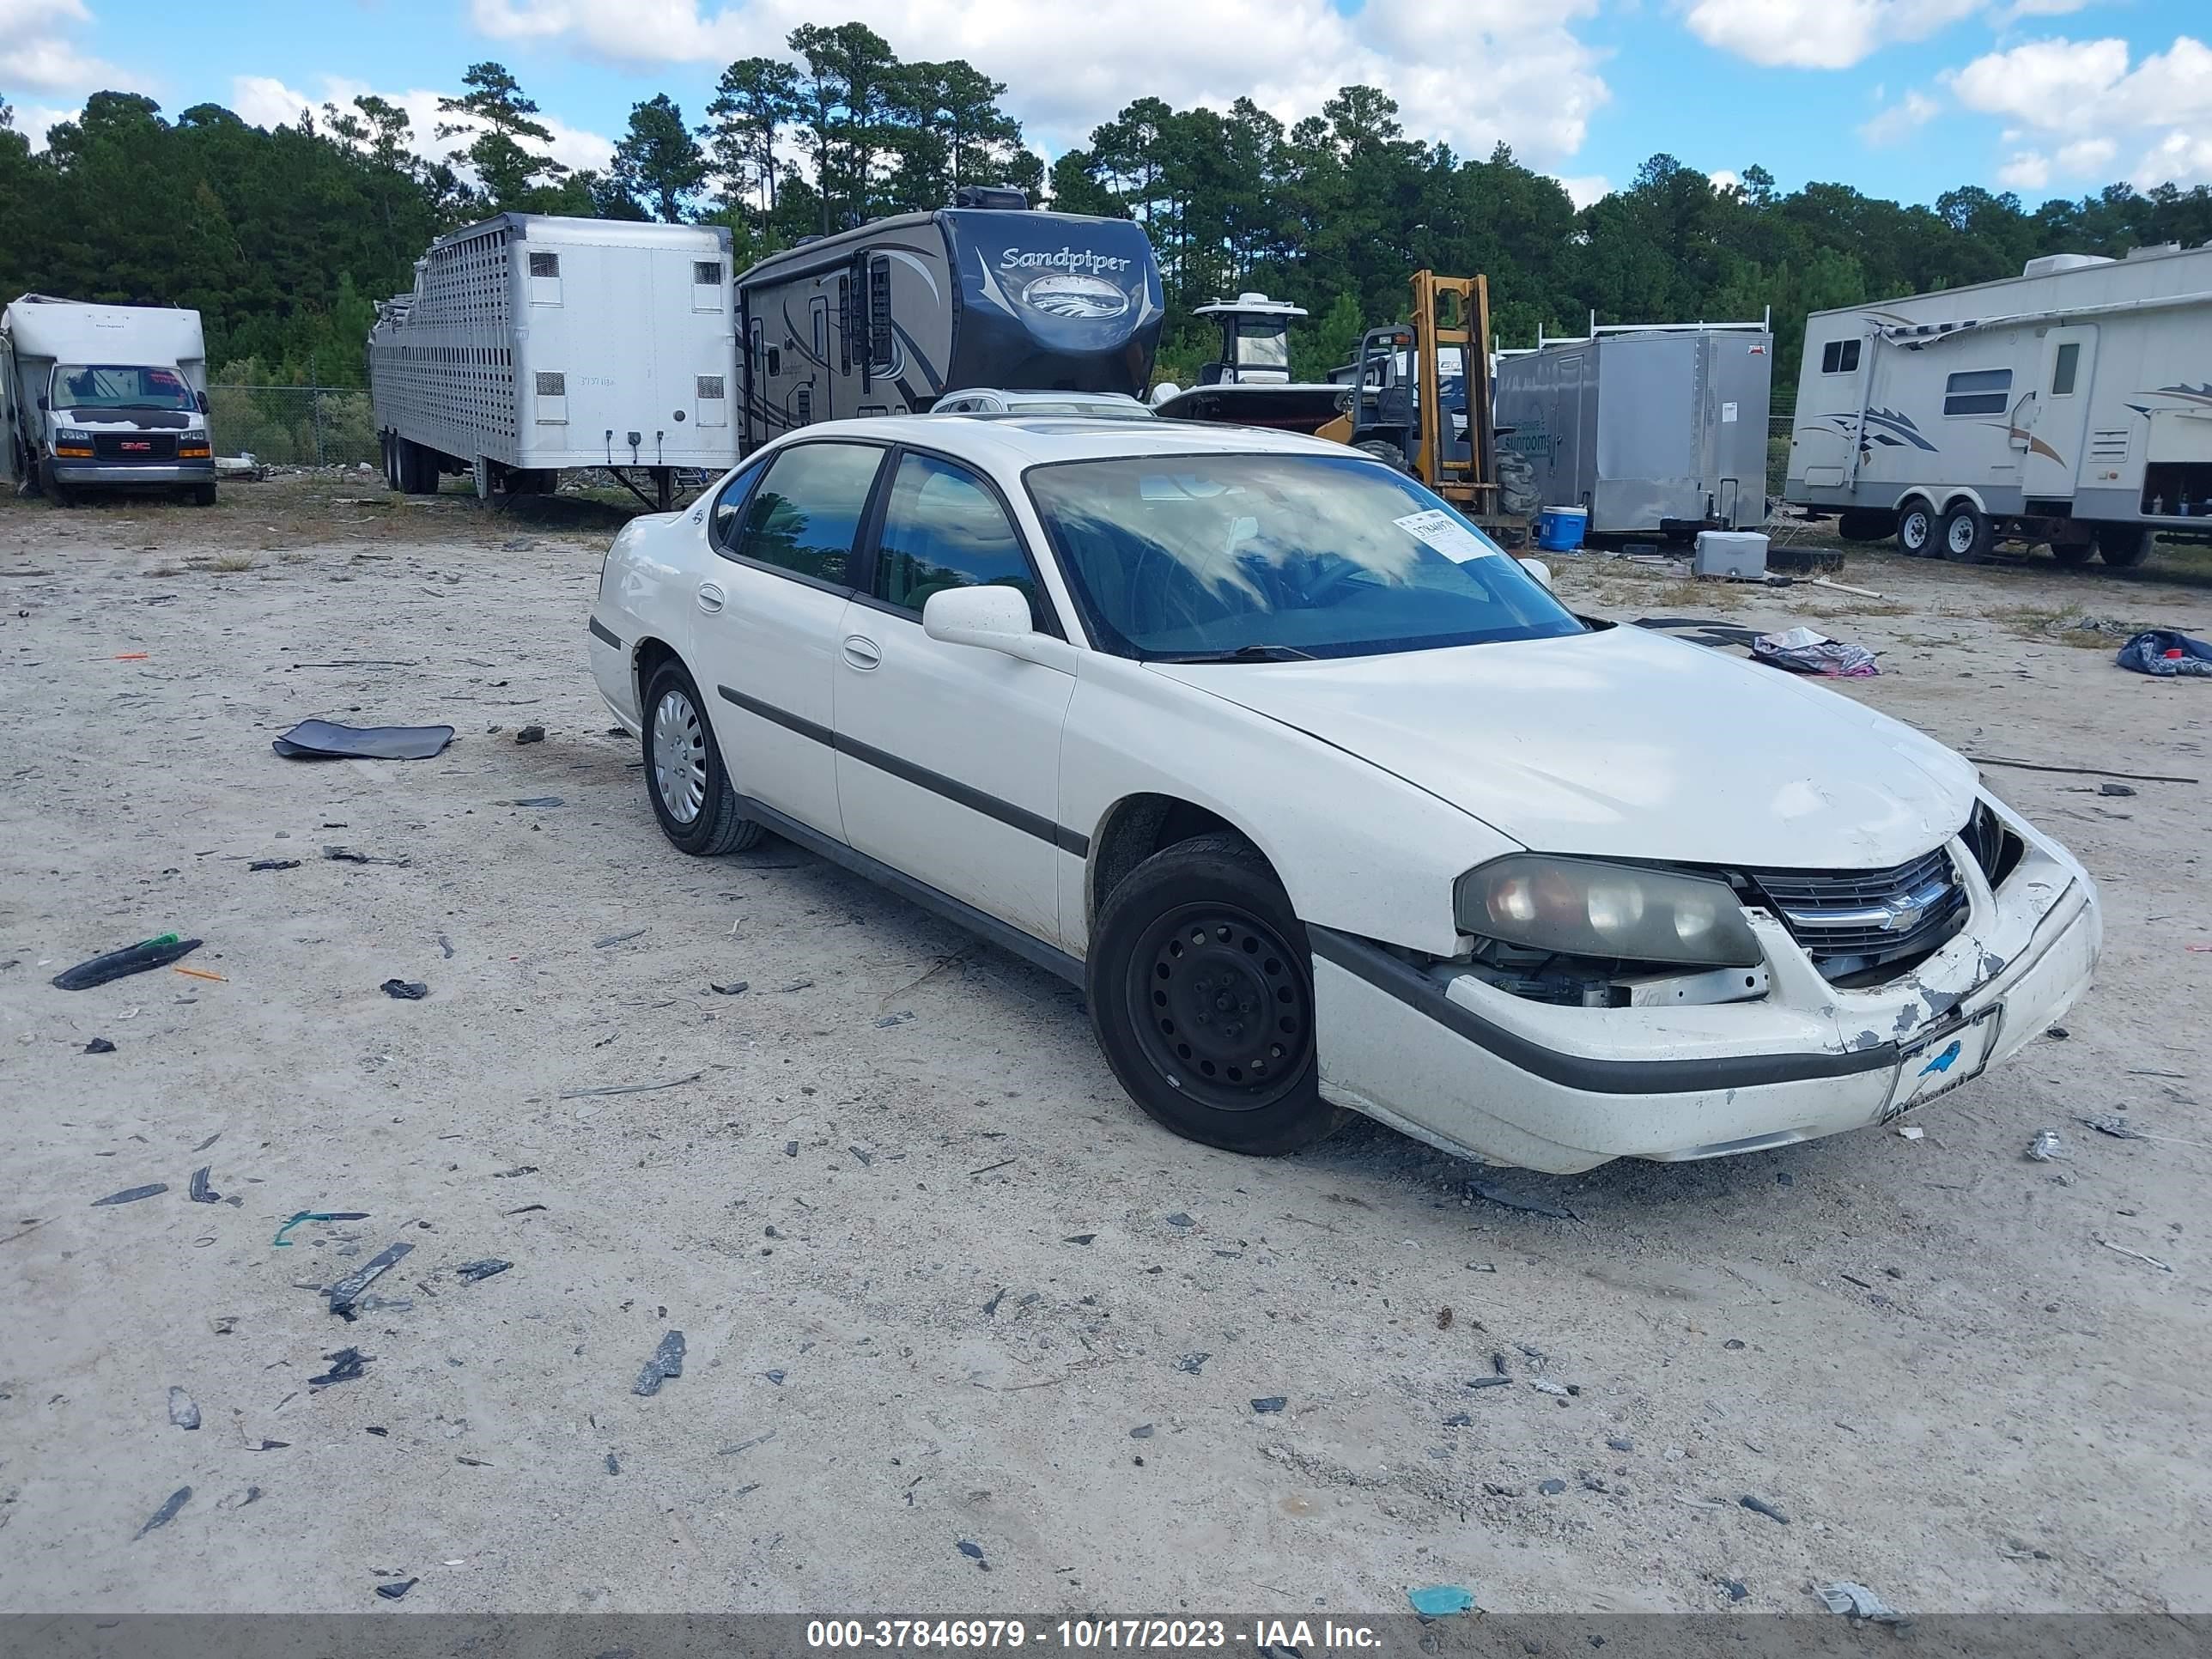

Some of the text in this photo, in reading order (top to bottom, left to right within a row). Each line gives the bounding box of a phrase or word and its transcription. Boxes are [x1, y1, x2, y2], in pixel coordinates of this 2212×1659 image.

[1000, 246, 1131, 275] Sandpiper
[120, 441, 151, 451] GMC
[1413, 520, 1456, 537] 37846979
